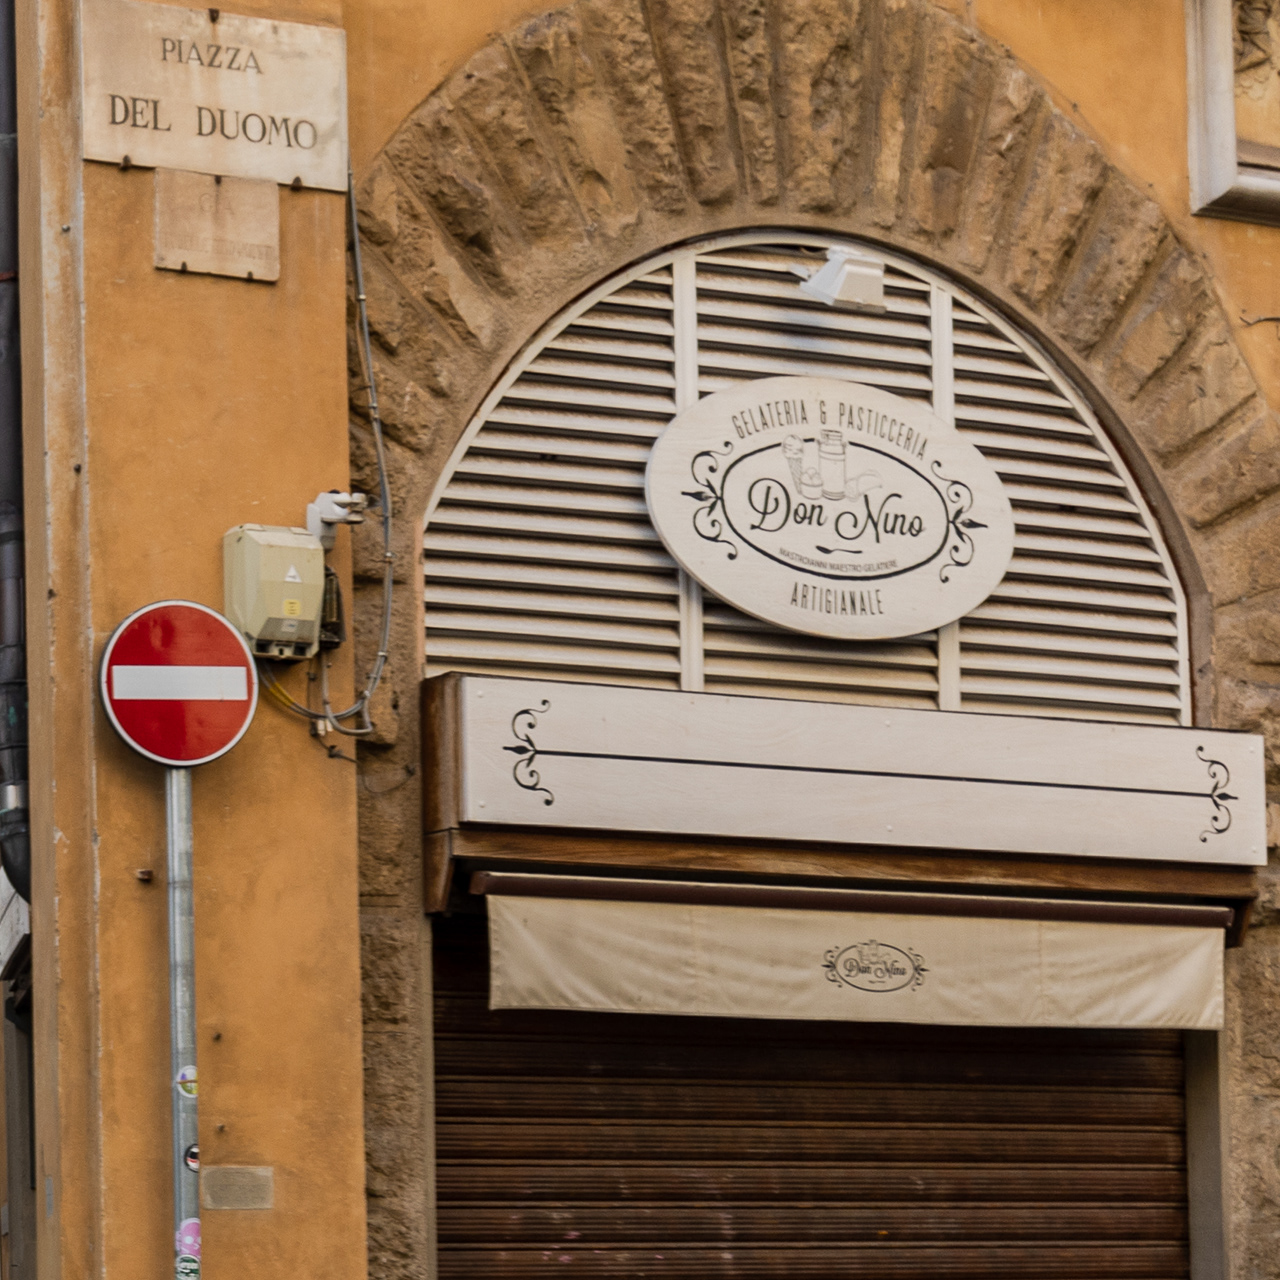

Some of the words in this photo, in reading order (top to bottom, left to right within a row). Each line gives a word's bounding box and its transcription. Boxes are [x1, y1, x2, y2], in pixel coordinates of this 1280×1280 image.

[160, 36, 264, 75] PIAZZA
[108, 93, 172, 132] DEL
[195, 104, 318, 150] DUOMO
[731, 398, 809, 440] GELATERIA
[819, 400, 827, 425] &
[839, 401, 929, 461] PASTICCERIA
[747, 477, 828, 533] Don
[834, 493, 926, 544] Nino
[790, 581, 885, 616] ARTIGIANALE
